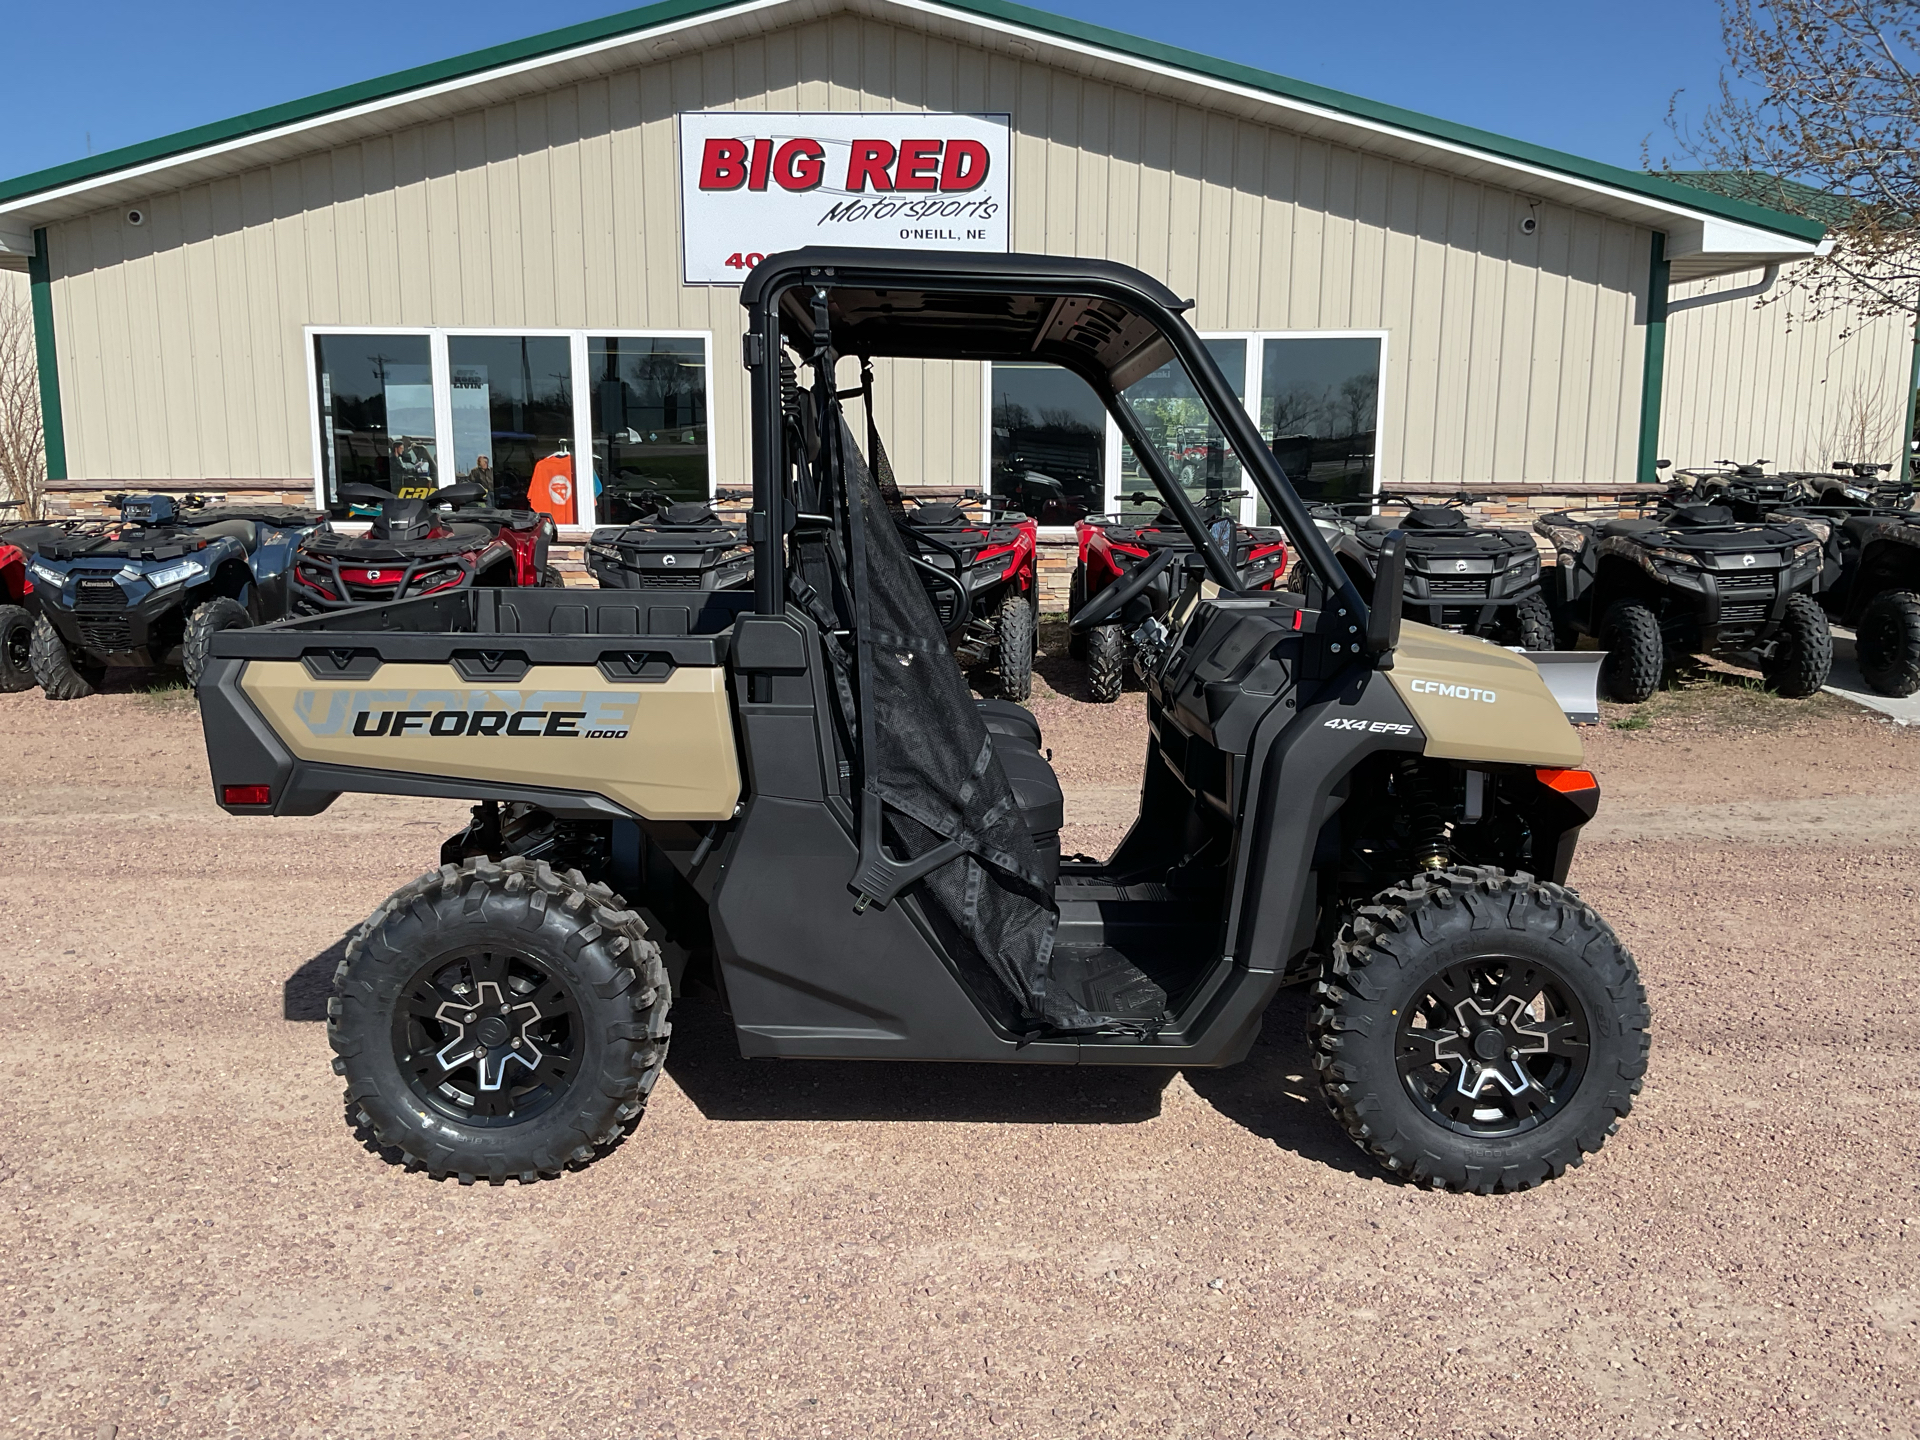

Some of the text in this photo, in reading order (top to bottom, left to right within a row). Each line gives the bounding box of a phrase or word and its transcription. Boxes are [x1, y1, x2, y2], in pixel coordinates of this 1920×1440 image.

[699, 138, 990, 193] BIG RED
[817, 196, 998, 226] Motorsports
[899, 229, 987, 241] O'NEILL, NE
[725, 252, 774, 270] 40
[81, 580, 114, 588] Kawasaki
[1411, 679, 1496, 703] CFMOTO
[352, 710, 629, 739] UFORCE 1000
[1323, 718, 1413, 735] 4X4 EPS
